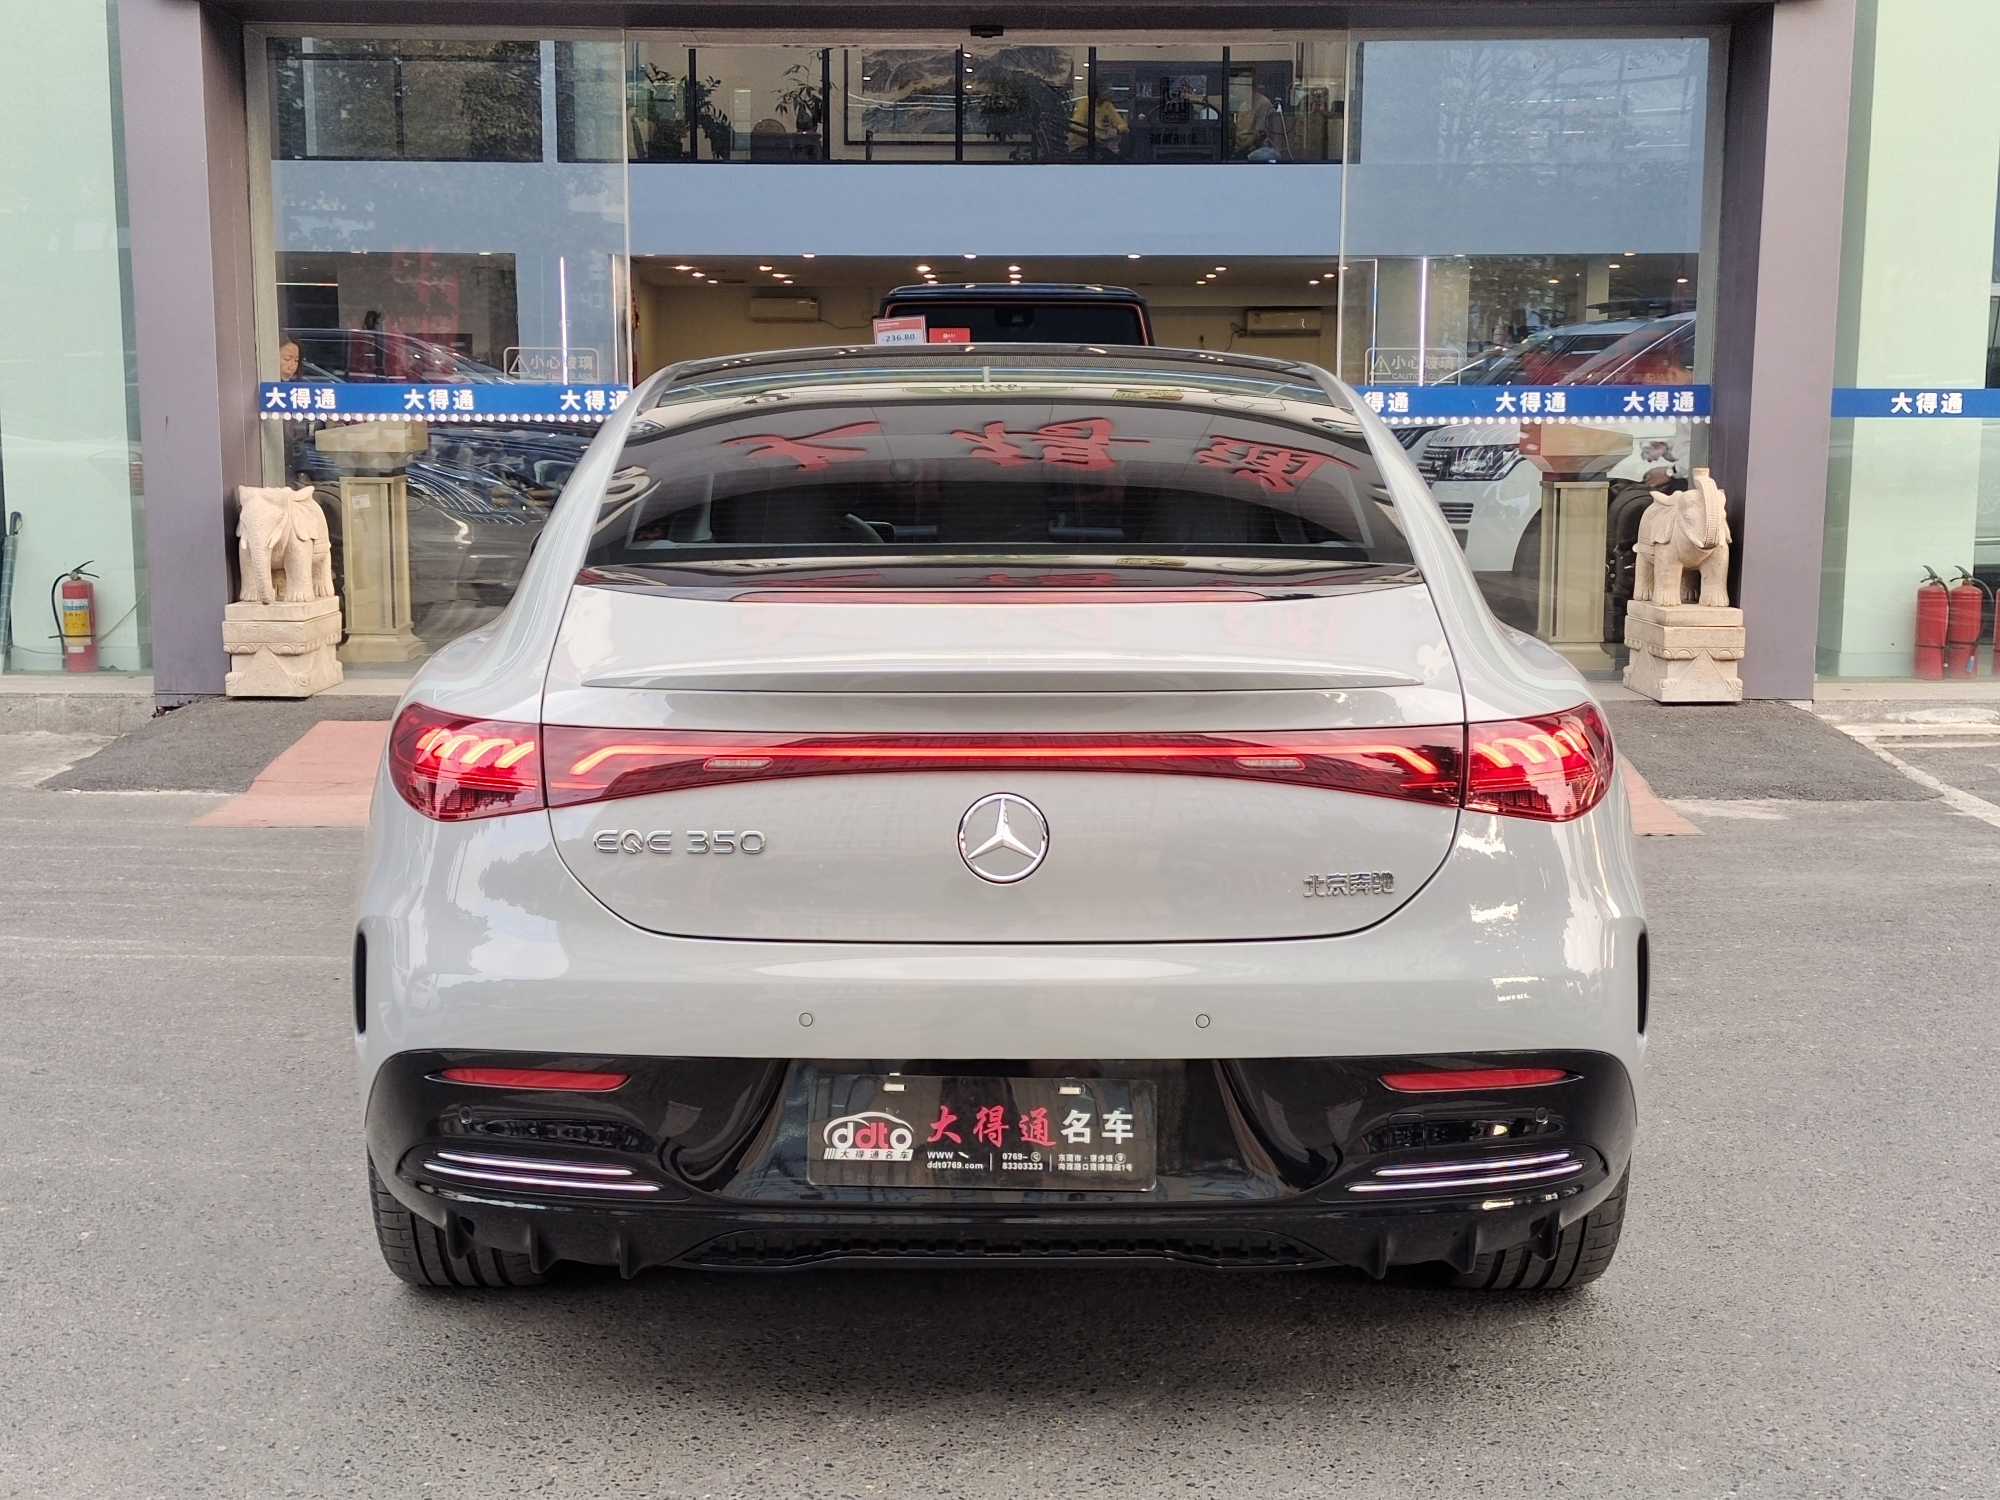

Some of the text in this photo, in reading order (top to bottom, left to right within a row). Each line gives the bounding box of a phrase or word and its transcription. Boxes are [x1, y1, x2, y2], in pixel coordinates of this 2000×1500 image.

[265, 387, 337, 409] 大得通
[403, 388, 475, 411] 大得通
[1363, 391, 1695, 414] 得通 大得通 大得通
[1890, 392, 1963, 414] 大得通
[593, 829, 767, 854] EQE 350
[1303, 870, 1395, 897] 北京奔驰
[926, 1105, 1135, 1148] 大得通名车
